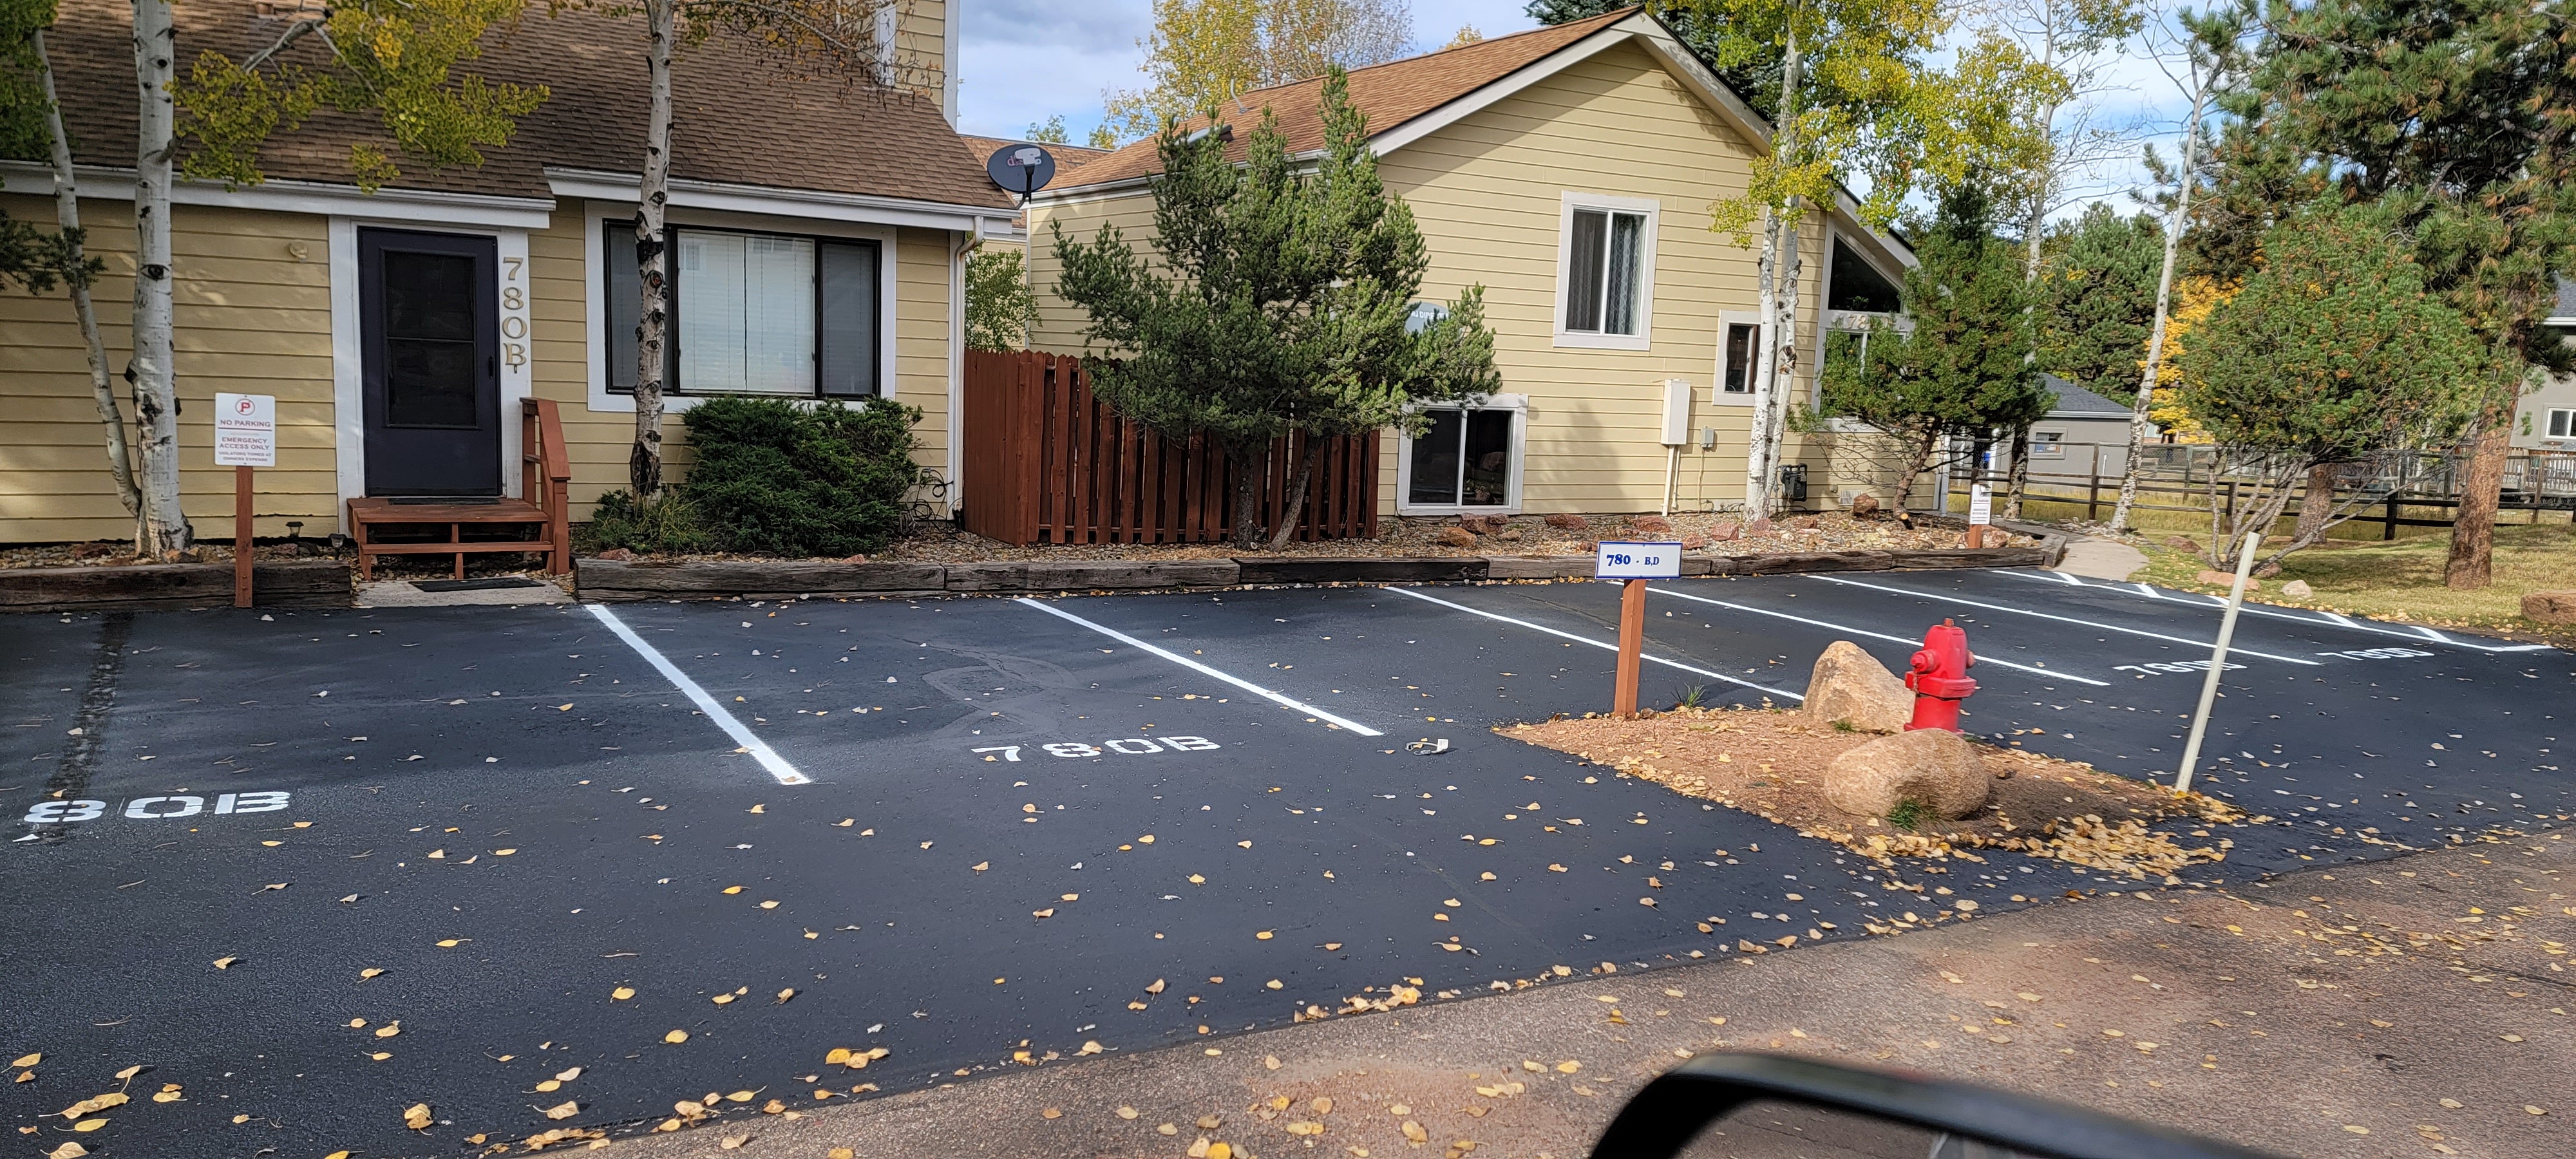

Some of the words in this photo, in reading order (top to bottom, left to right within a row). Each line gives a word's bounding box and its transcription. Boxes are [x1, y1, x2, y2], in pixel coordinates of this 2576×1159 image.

[502, 257, 527, 365] 780B
[1606, 553, 1631, 566] 780
[1644, 556, 1660, 567] B,D
[971, 736, 1221, 762] 780B
